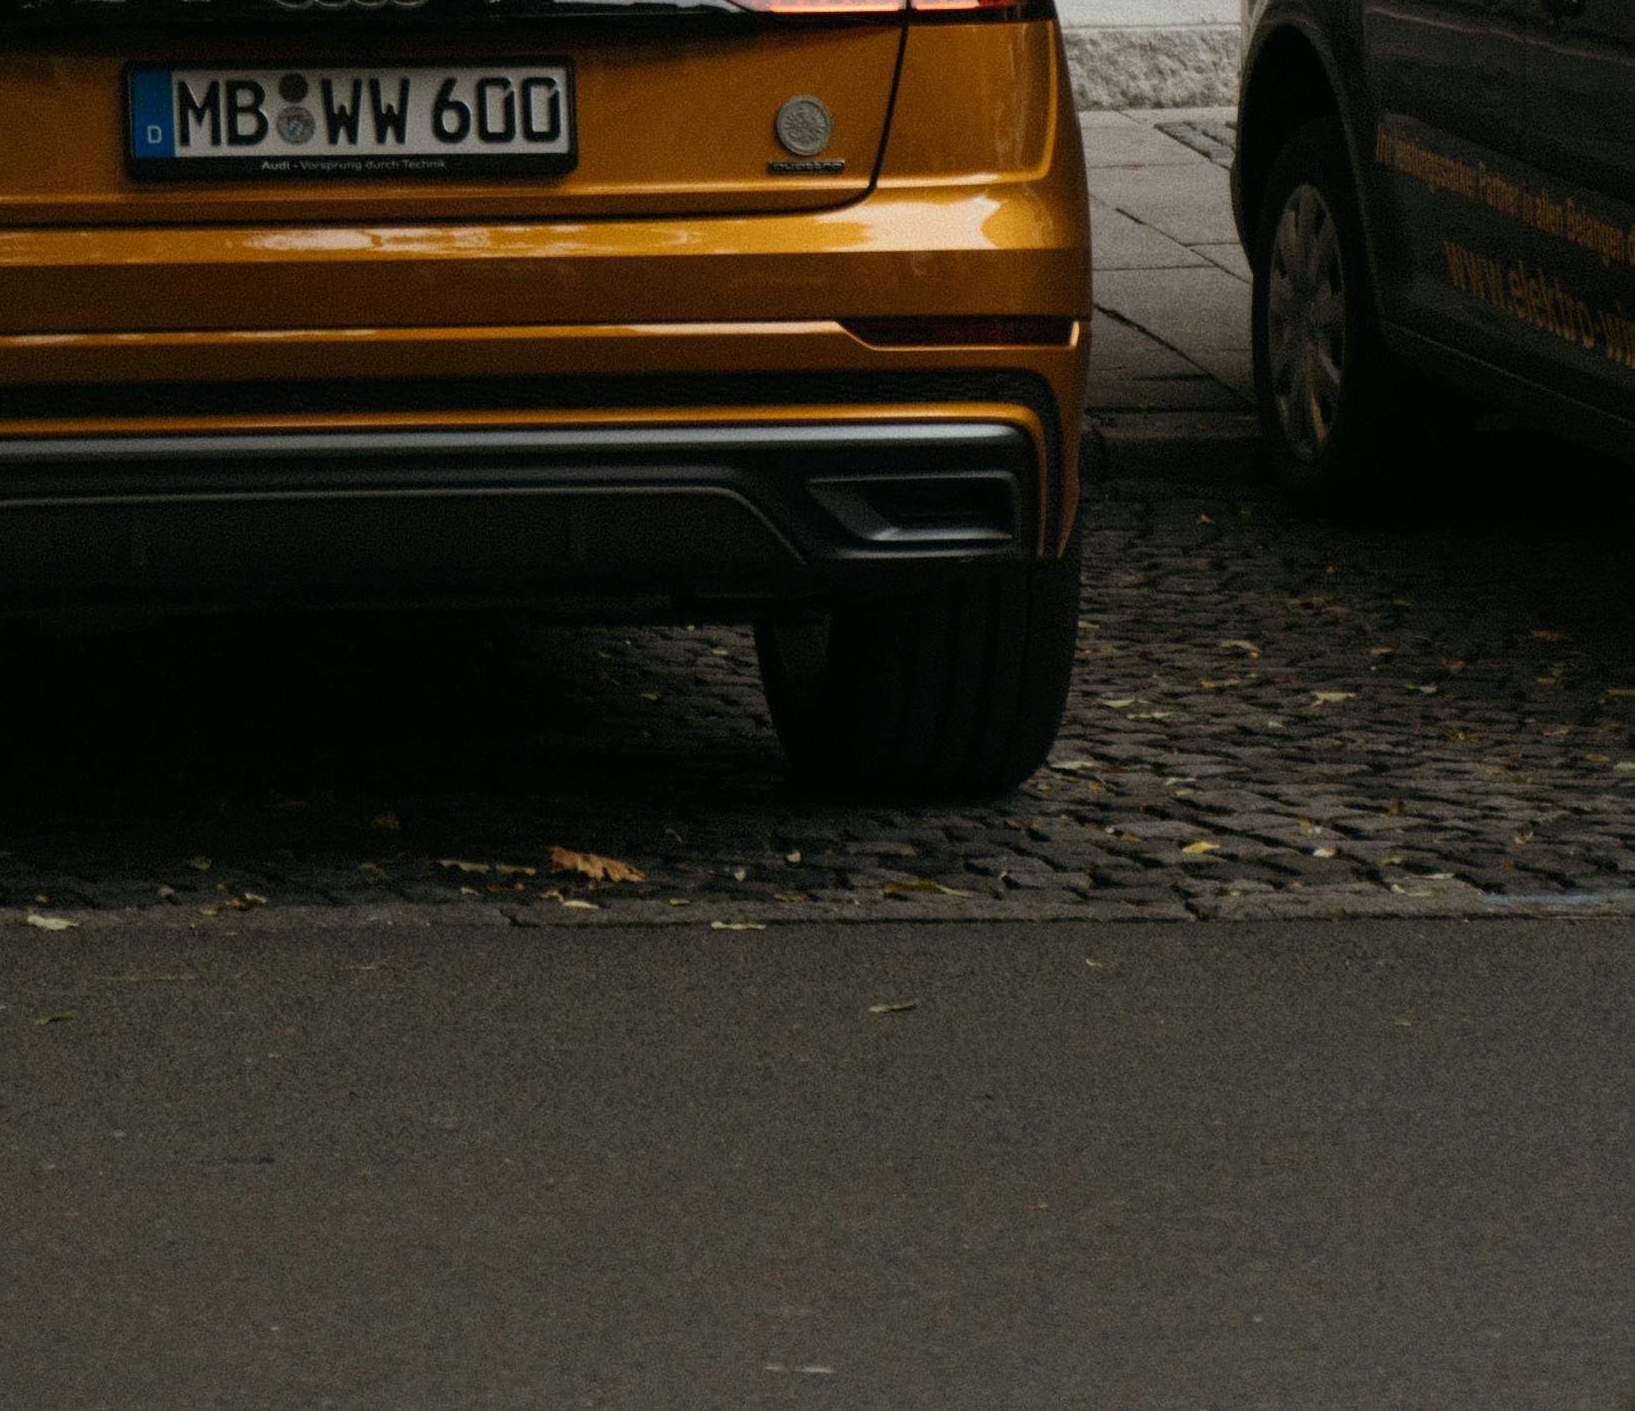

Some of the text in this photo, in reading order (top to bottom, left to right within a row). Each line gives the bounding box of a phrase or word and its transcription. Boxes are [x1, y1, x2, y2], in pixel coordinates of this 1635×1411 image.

[146, 76, 562, 148] D MB WW 600
[262, 160, 290, 171] Audi
